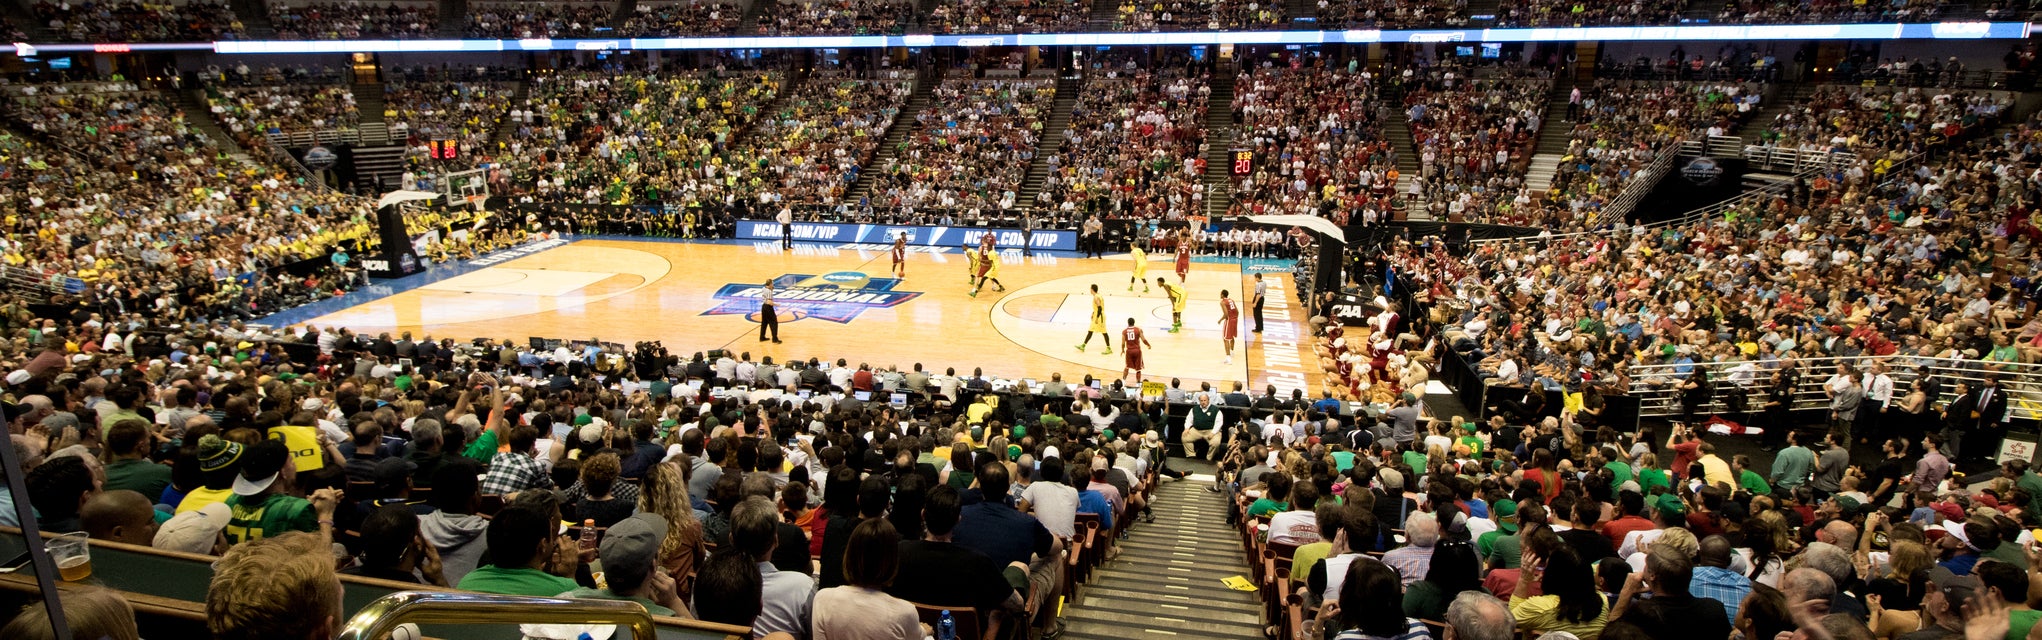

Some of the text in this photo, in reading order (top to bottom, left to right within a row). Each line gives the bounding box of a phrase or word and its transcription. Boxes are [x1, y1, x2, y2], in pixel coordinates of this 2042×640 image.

[94, 43, 130, 53] BONUS
[1237, 151, 1253, 160] 8:32
[1235, 160, 1250, 174] 20
[963, 230, 1058, 247] NC.COM/VIP
[362, 260, 390, 271] NCAA
[1332, 304, 1364, 318] CAA
[1126, 331, 1136, 341] 10
[1263, 340, 1302, 368] FINAL
[1470, 442, 1478, 454] 3
